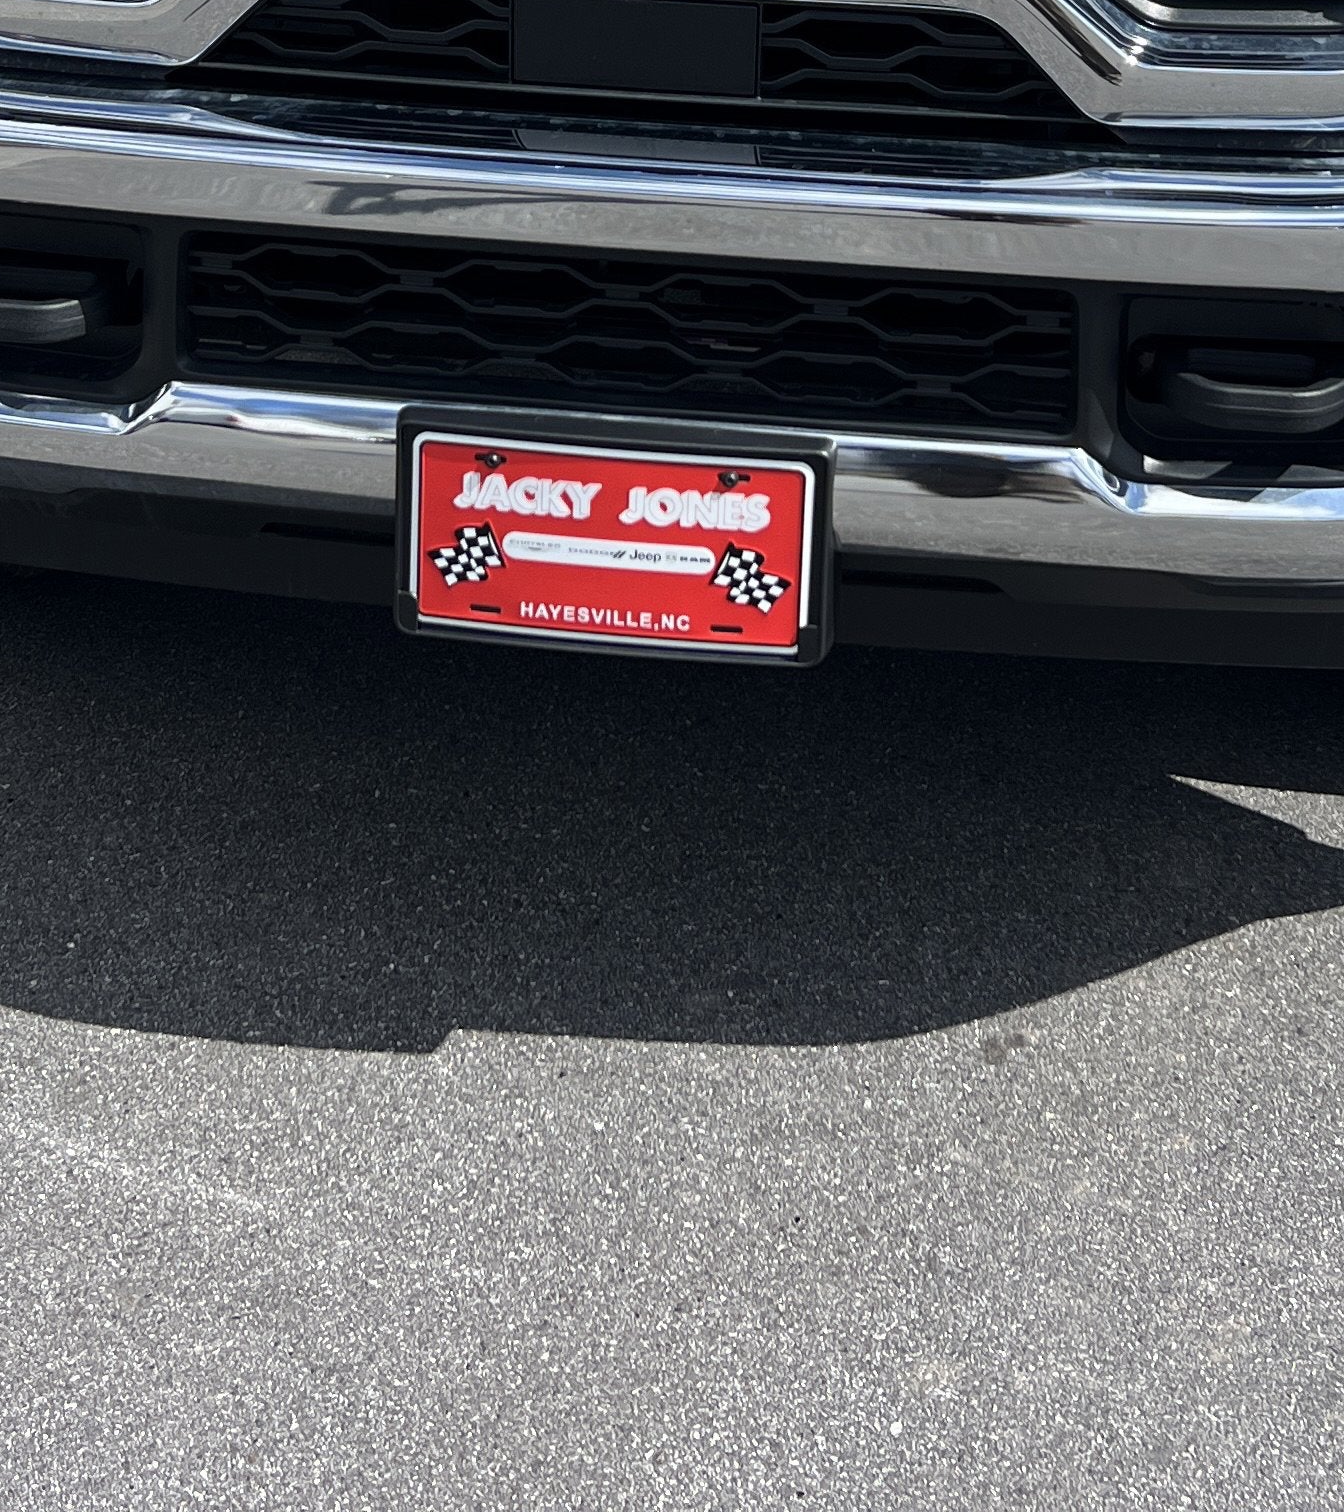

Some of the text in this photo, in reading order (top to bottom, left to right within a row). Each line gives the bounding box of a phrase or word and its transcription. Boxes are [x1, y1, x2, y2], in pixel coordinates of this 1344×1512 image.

[453, 471, 771, 533] JACKY JONES
[629, 549, 662, 563] Jeep
